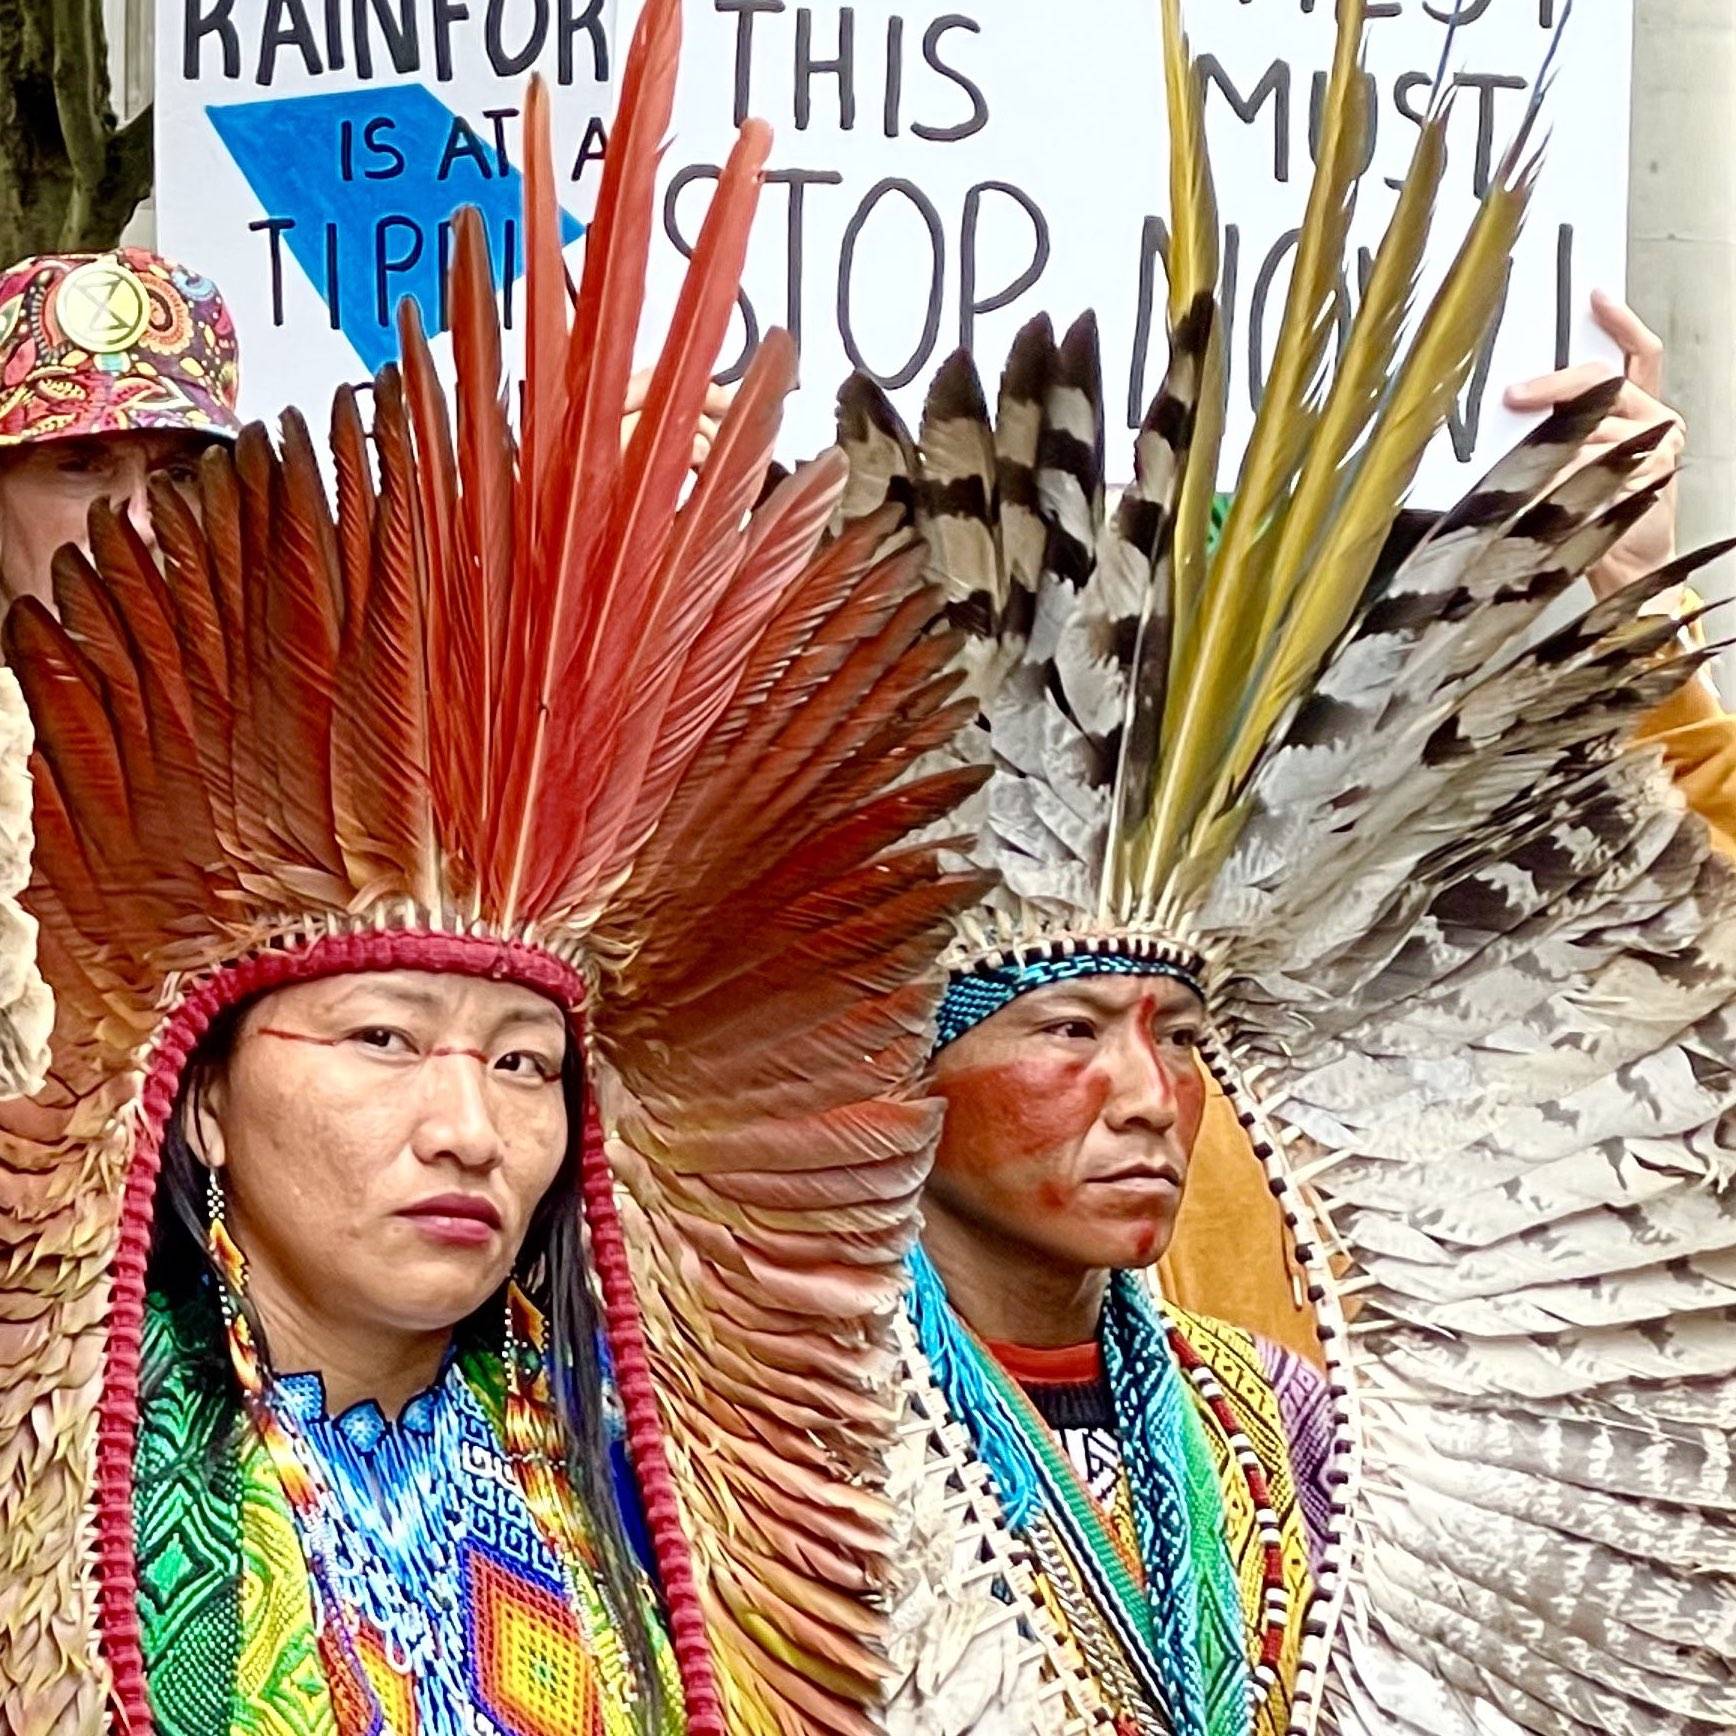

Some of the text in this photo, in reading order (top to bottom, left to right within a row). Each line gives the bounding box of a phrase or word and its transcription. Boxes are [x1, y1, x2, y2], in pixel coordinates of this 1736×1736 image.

[715, 0, 989, 142] THIS
[341, 117, 405, 181] IS
[437, 108, 519, 181] AT
